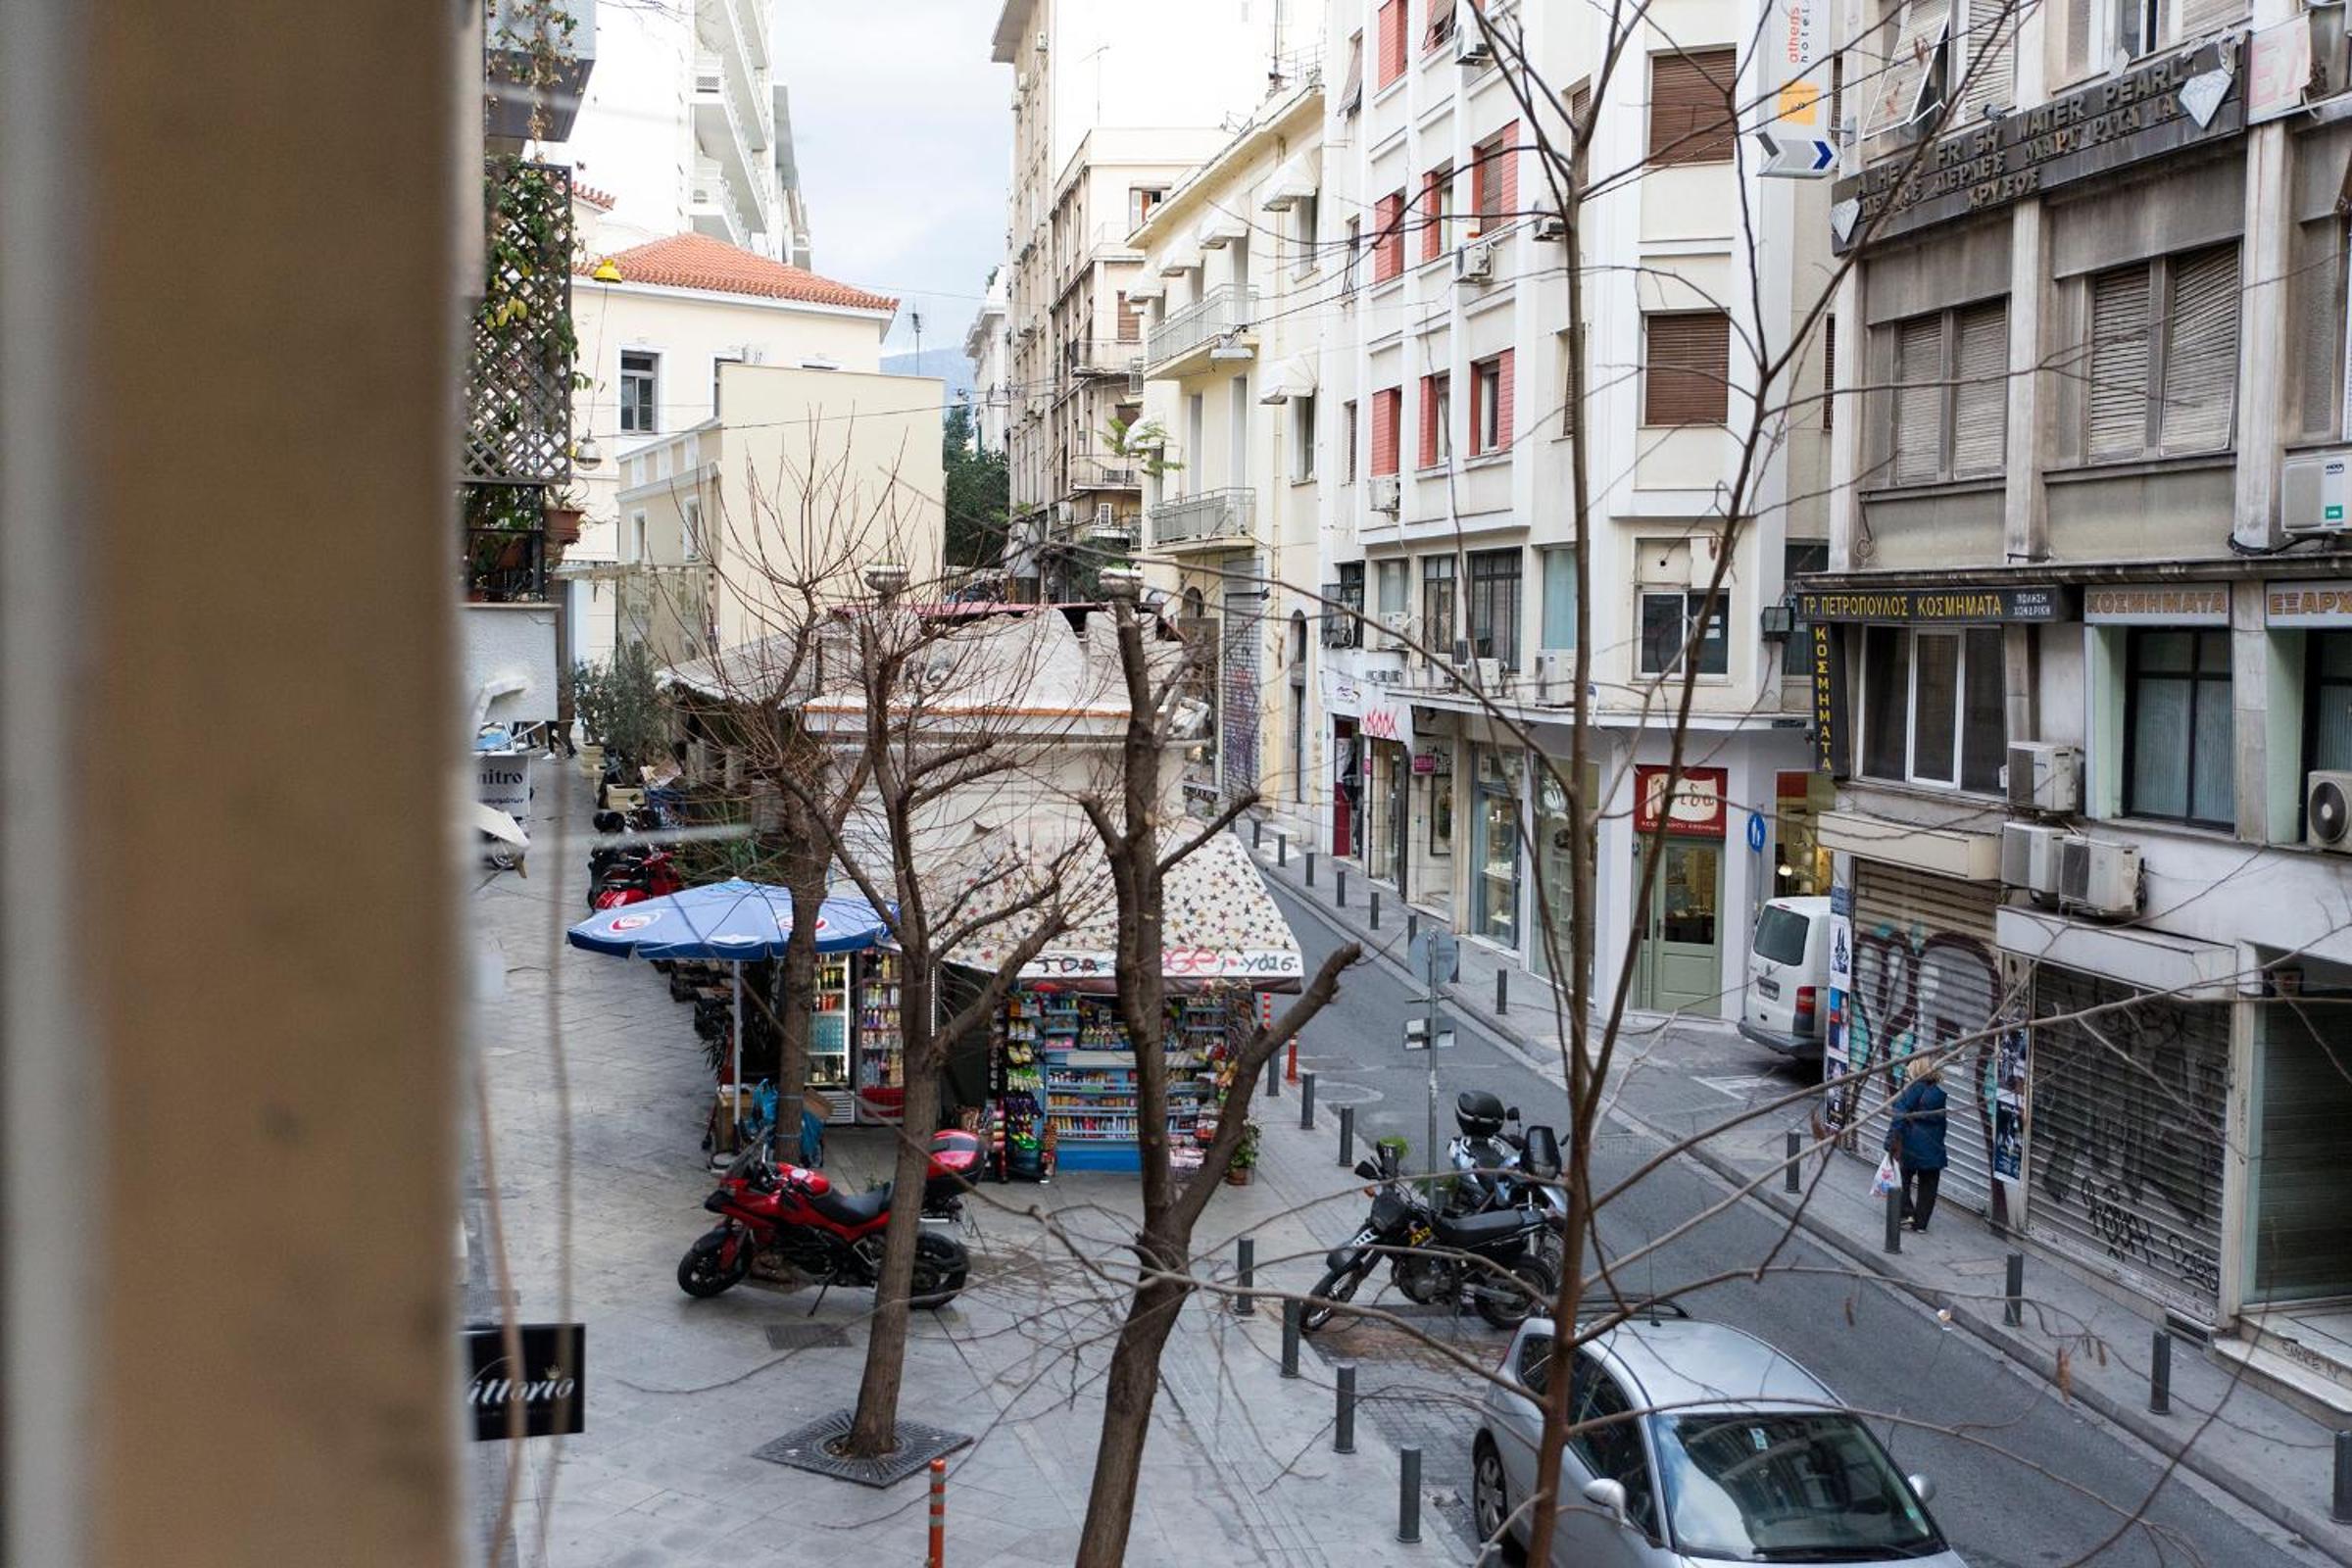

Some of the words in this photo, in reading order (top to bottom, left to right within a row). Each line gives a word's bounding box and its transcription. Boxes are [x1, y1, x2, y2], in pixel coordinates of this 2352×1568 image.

[1788, 7, 1799, 63] athens
[2017, 95, 2084, 139] WATER
[2104, 60, 2184, 106] PEARL
[1821, 596, 1908, 616] ΠΕΤΡΟΠΟΥΛΟΣ
[1917, 595, 2002, 616] ΚΟΣΜΗΜΑΤΑ
[2086, 591, 2228, 614] ΚΟΣΜΗΜΑΤΑ
[1815, 626, 1833, 771] ΚΟΣΜΗΜΑΤΑ
[466, 1372, 575, 1405] ittorio
